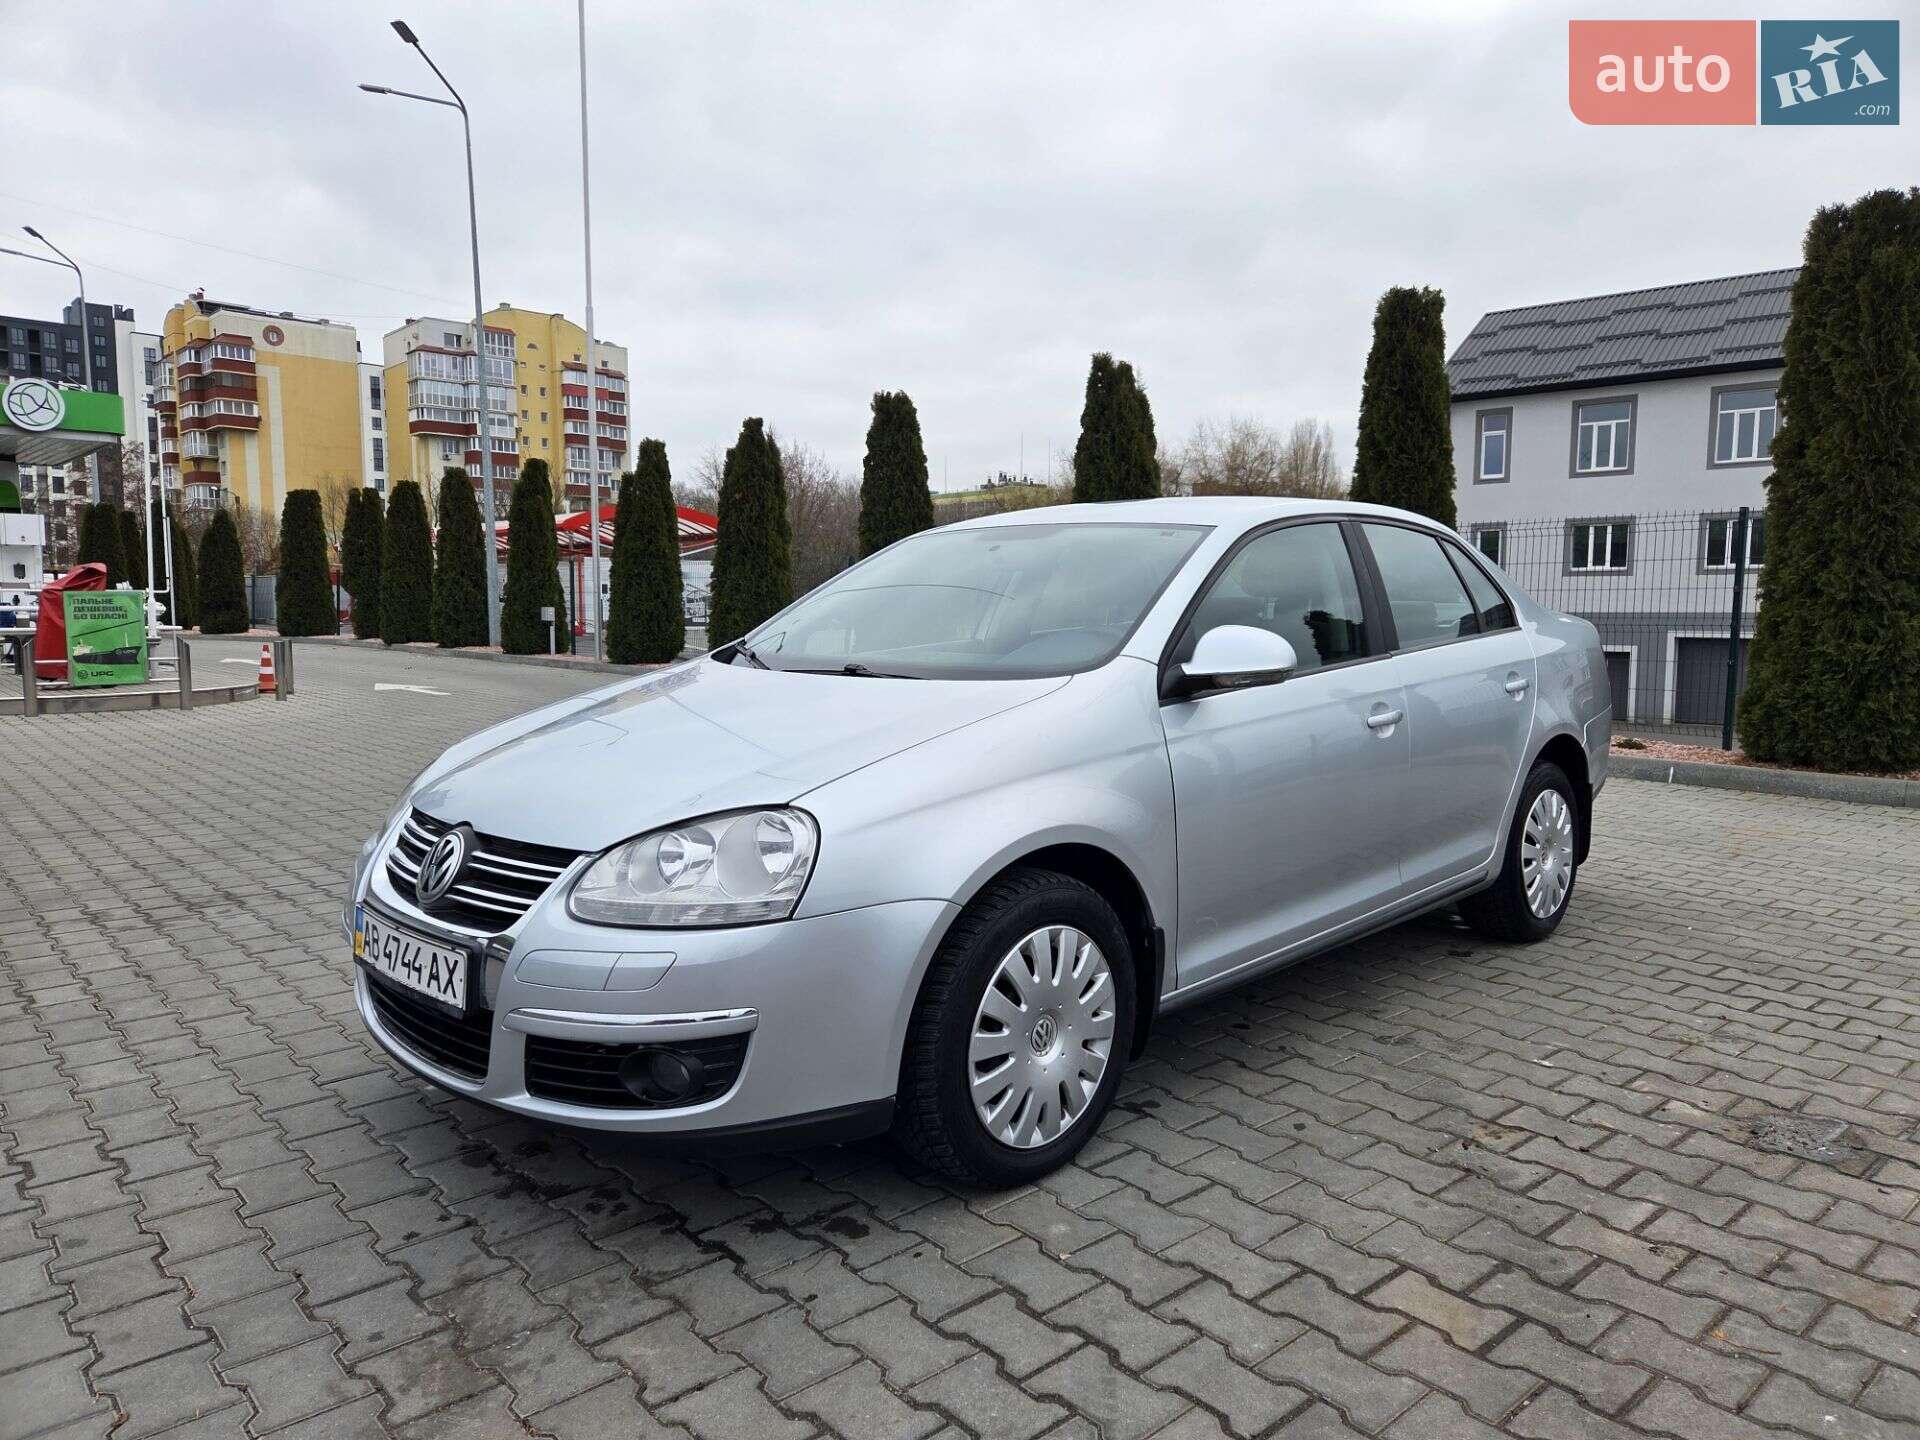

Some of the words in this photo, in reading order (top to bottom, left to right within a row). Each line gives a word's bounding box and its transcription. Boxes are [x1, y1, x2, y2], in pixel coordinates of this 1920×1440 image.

[363, 919, 380, 962] AB
[383, 933, 423, 985] 4744
[426, 951, 459, 1000] AX
